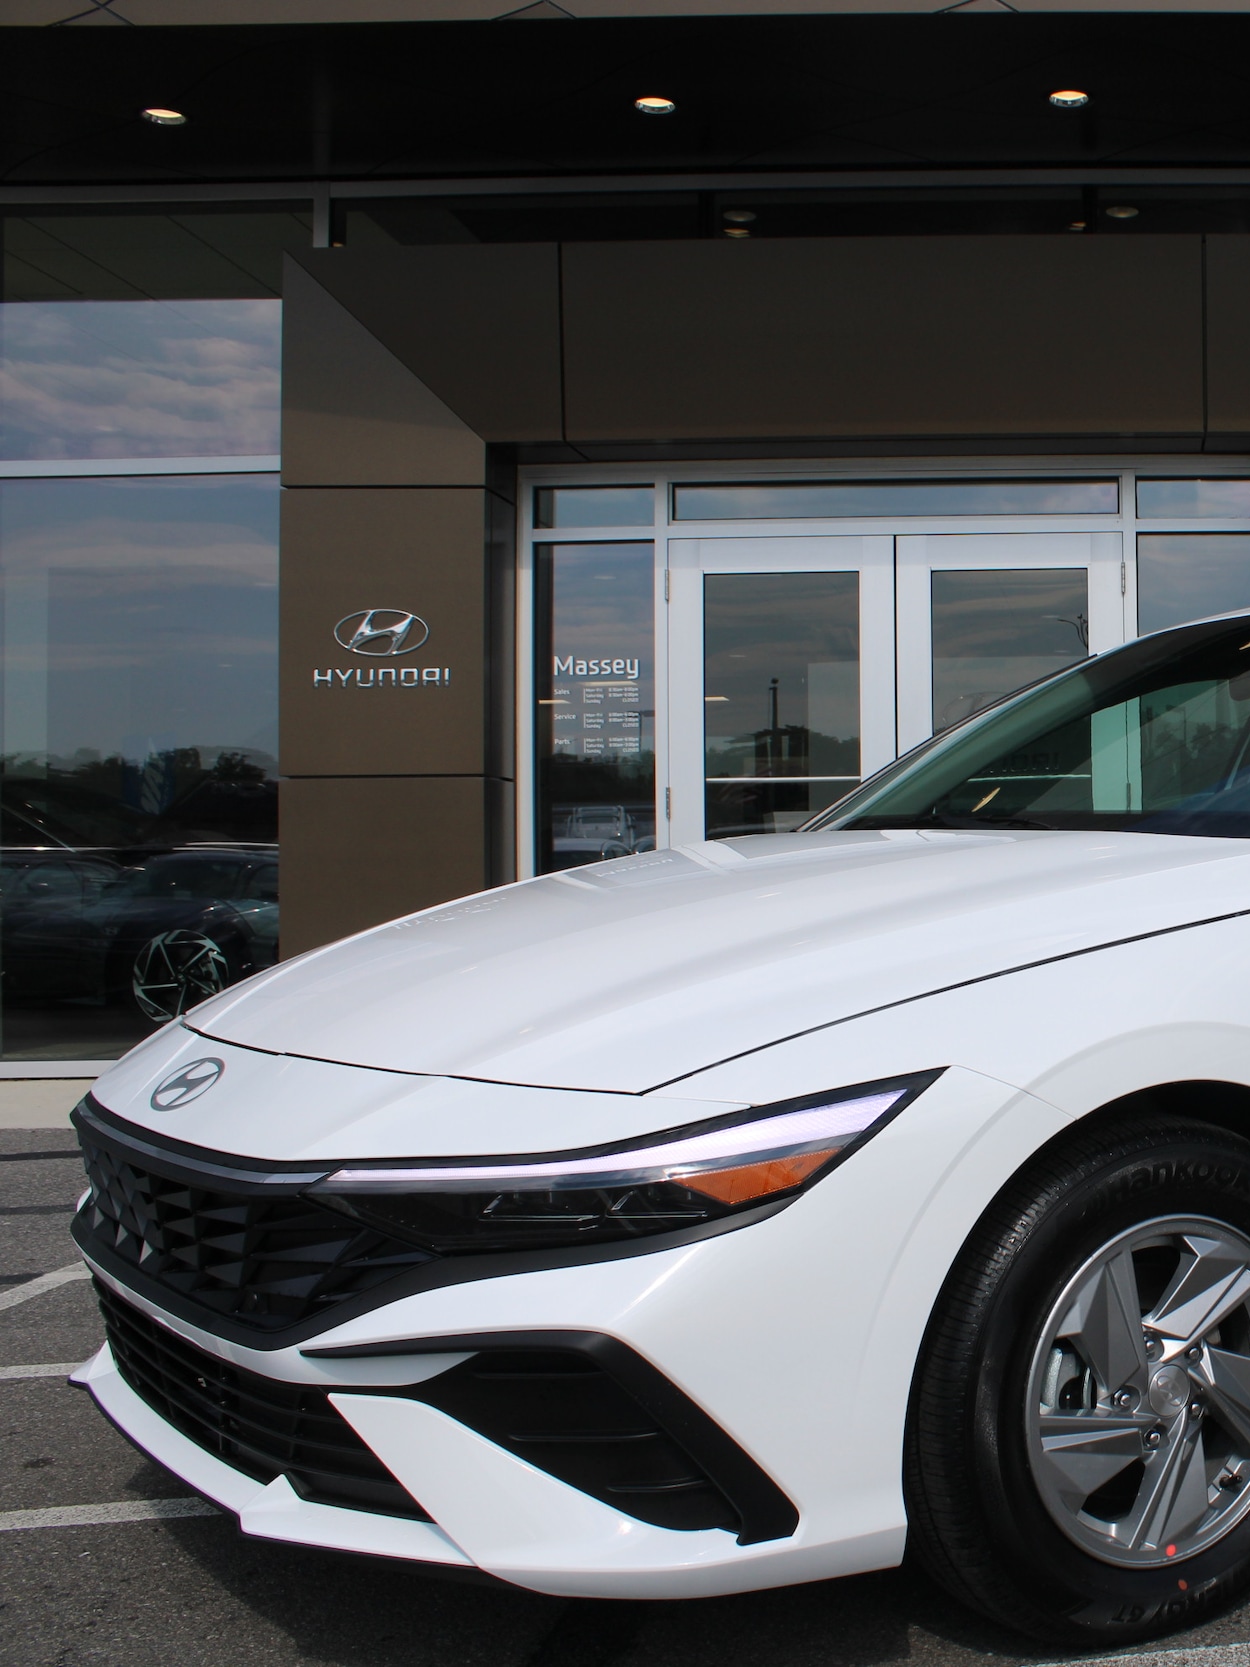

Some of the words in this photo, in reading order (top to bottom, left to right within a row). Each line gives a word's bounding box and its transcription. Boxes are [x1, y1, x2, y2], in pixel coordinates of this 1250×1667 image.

[313, 668, 450, 688] HYUNDAI
[553, 655, 639, 680] Massey
[1105, 1159, 1250, 1201] Hankook
